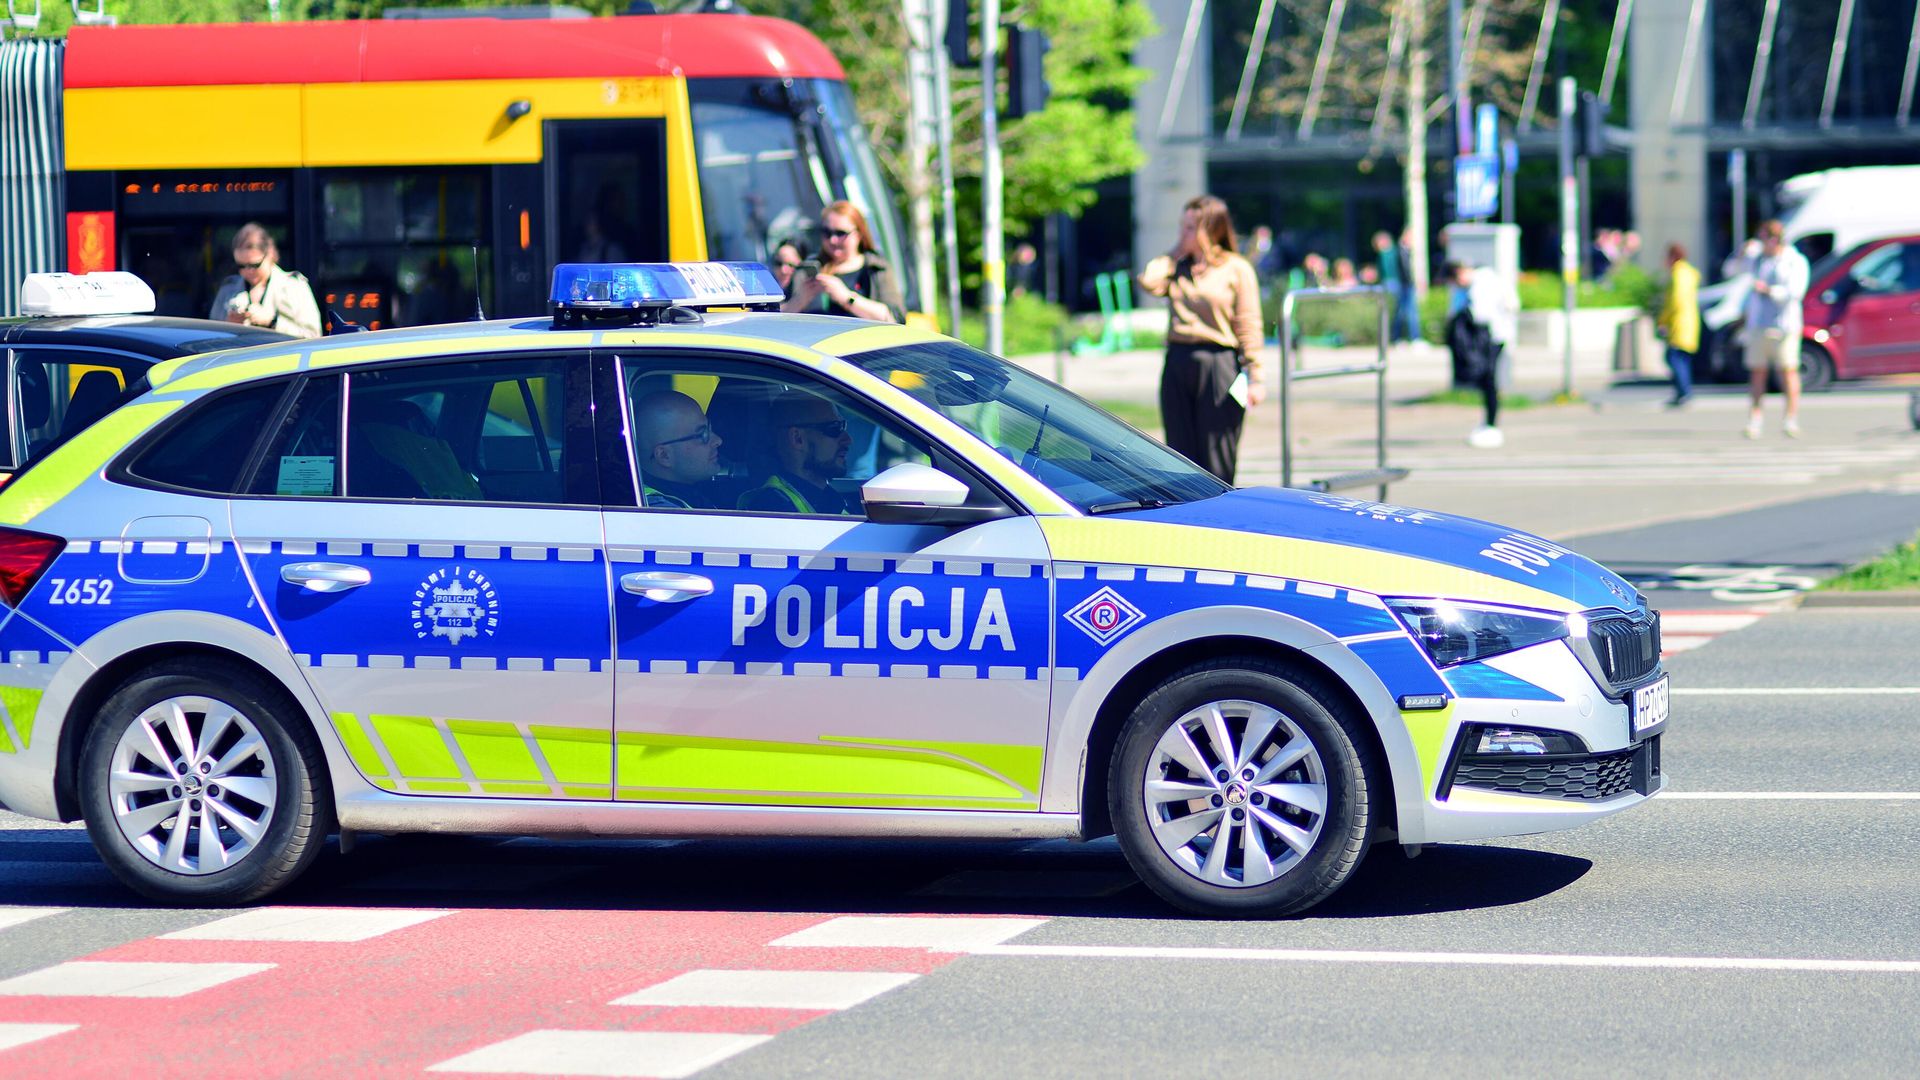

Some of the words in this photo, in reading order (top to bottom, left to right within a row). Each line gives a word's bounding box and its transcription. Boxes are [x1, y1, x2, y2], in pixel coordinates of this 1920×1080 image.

[679, 266, 742, 295] POLICJA
[48, 578, 114, 605] Z652
[411, 568, 446, 639] POMAGAMY
[455, 566, 460, 576] I
[468, 569, 499, 637] CHRONIMY
[436, 595, 473, 603] POLICJA
[447, 618, 462, 627] 112
[732, 583, 1016, 651] POLICJA
[1099, 609, 1111, 624] R
